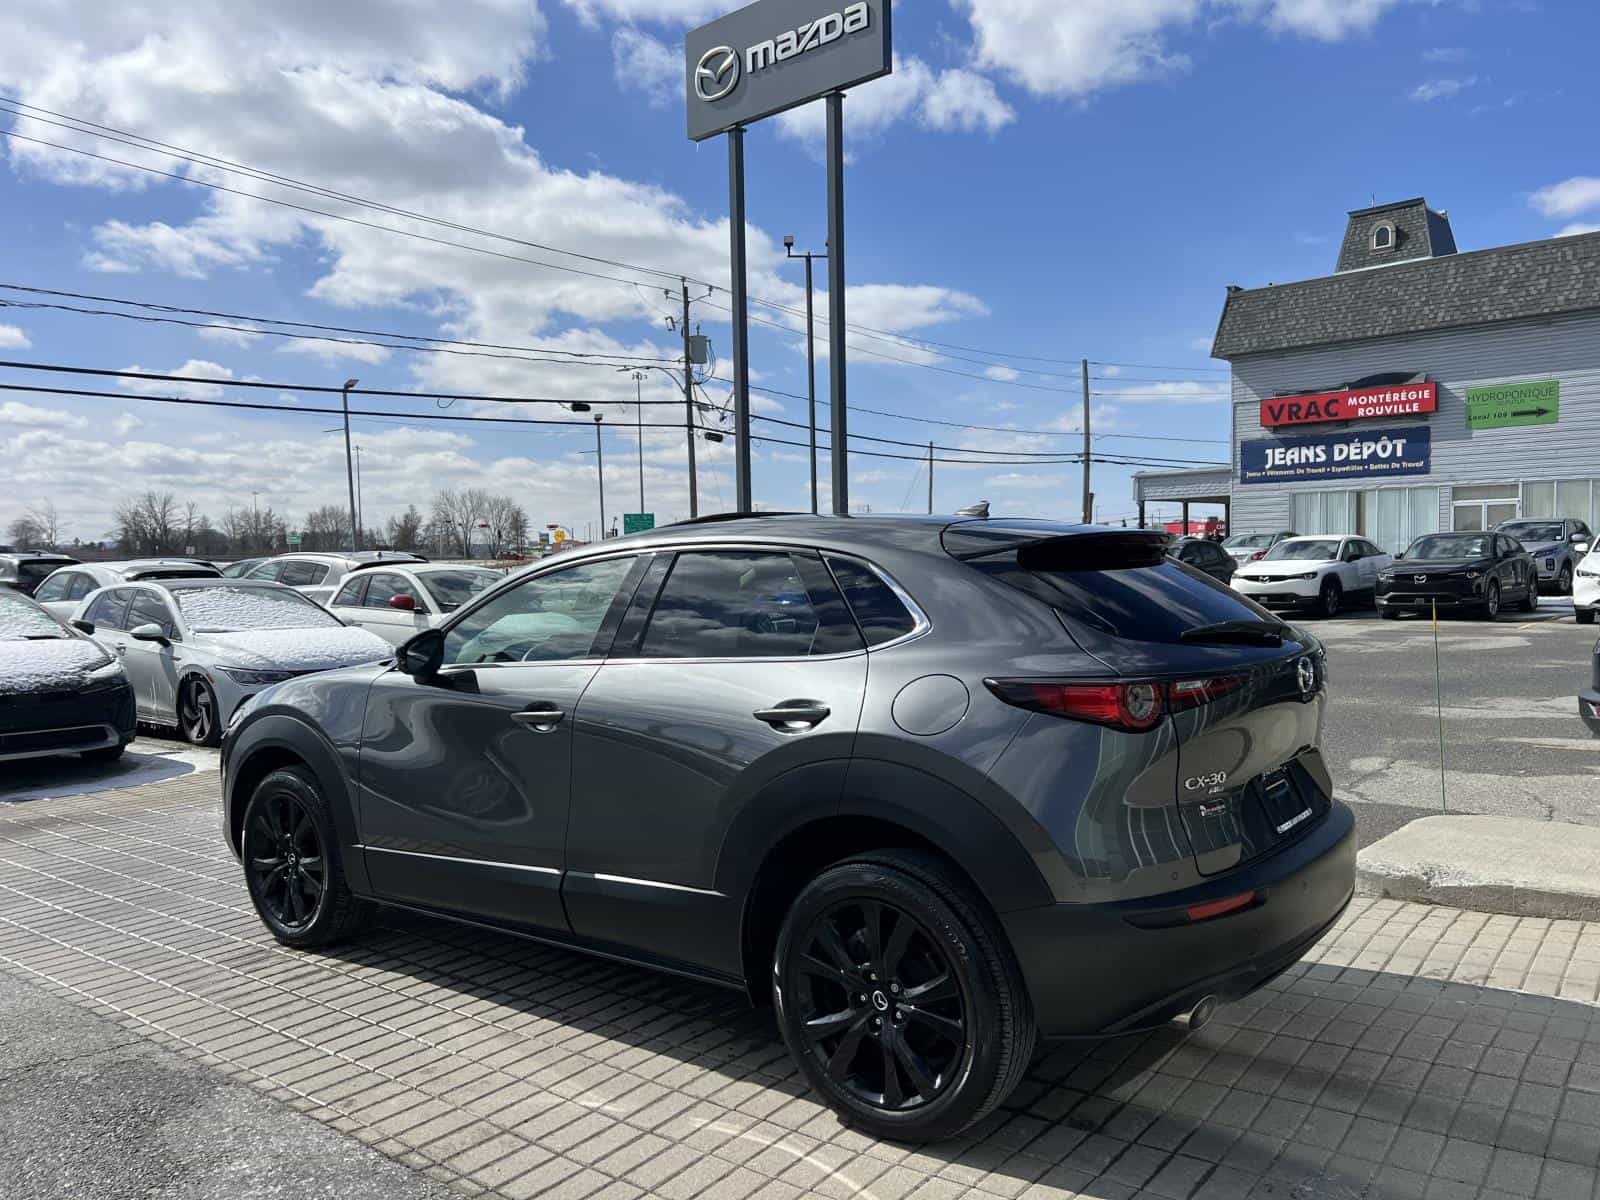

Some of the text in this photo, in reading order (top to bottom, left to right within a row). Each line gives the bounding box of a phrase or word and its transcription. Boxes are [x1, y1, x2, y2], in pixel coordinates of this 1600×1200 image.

[1347, 389, 1431, 407] MONTÉRÉGIE
[1467, 386, 1555, 403] HYDROPONIQUE
[1267, 399, 1340, 422] VRAC
[1357, 402, 1420, 417] ROUVILLE
[1264, 436, 1406, 469] JEANS DÉPÔT
[1185, 771, 1226, 790] CX-30
